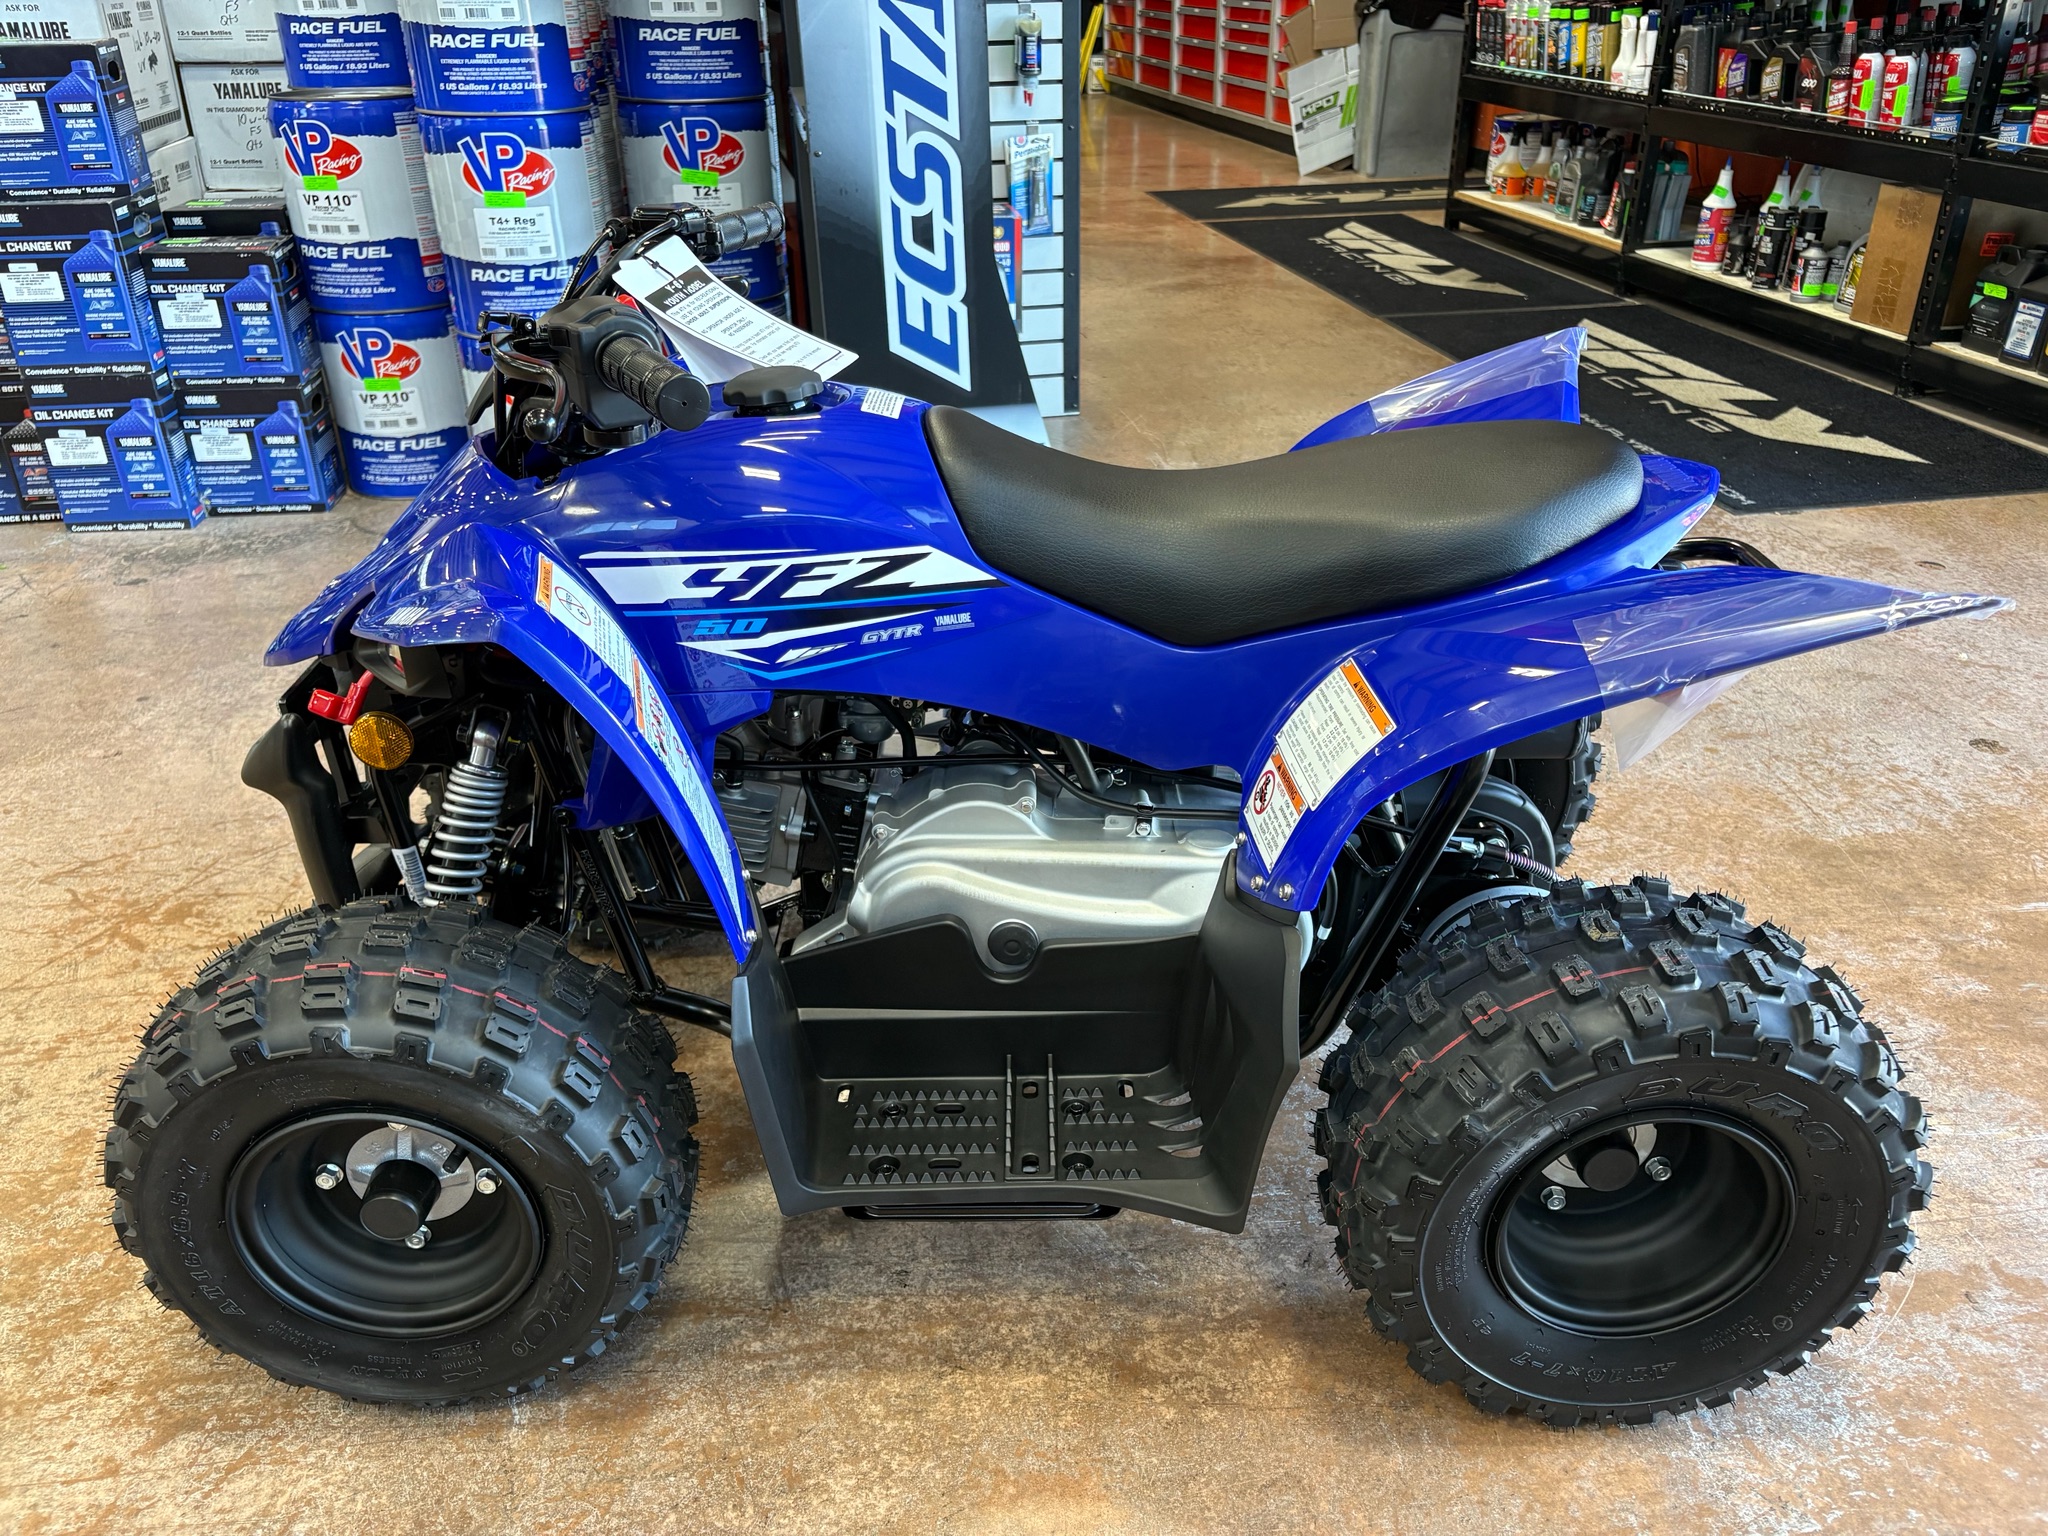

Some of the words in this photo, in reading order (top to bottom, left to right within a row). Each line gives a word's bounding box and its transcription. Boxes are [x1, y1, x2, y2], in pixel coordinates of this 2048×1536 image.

[23, 4, 40, 12] FOR
[0, 22, 71, 39] AMALUBE
[290, 22, 334, 35] RACE
[338, 21, 387, 34] FUEL
[639, 28, 691, 41] RACE
[696, 27, 741, 41] FUEL
[430, 34, 485, 48] RACE
[491, 33, 545, 48] FUEL
[230, 68, 244, 76] ASK
[245, 67, 260, 75] FOR
[314, 63, 338, 71] Gallons
[345, 62, 367, 70] 18.93
[664, 72, 692, 80] Gallons
[0, 83, 29, 93] ANGE
[29, 82, 46, 92] KIT
[458, 83, 489, 91] Gallons
[524, 82, 547, 90] Liters
[59, 103, 94, 113] YAMALUBE
[279, 120, 333, 176] VP
[317, 153, 362, 176] Racing
[660, 117, 721, 171] VP
[704, 149, 744, 171] Racing
[457, 132, 527, 192] VP
[508, 168, 555, 191] Racing
[9, 189, 48, 197] Convenience
[52, 188, 82, 196] Durability
[86, 186, 116, 194] Reliability
[693, 185, 720, 196] T2+
[303, 194, 319, 206] VP
[325, 195, 351, 206] 110
[172, 217, 204, 226] YAMALUBE
[489, 217, 510, 226] T4+
[514, 216, 536, 227] Reg
[6, 242, 53, 252] CHANGE
[54, 241, 72, 250] KIT
[301, 245, 338, 259] RACE
[342, 245, 393, 259] FUEL
[152, 258, 186, 267] YAMALUBE
[1308, 237, 1412, 286] RACING
[77, 273, 112, 282] YAMALUBE
[471, 269, 524, 283] RACE
[151, 285, 168, 294] OIL
[170, 284, 208, 293] CHANGE
[209, 284, 226, 292] KIT
[664, 291, 687, 307] YOUTH
[236, 302, 268, 312] YAMALUBE
[335, 327, 393, 379] VP
[377, 356, 421, 378] Racing
[25, 368, 69, 376] Convenience
[74, 366, 106, 374] Durability
[112, 365, 145, 373] Reliability
[2, 385, 23, 393] BOTT
[31, 384, 64, 394] YAMALUBE
[185, 395, 217, 405] YAMALUBE
[359, 393, 377, 404] VP
[385, 391, 409, 403] 110
[1579, 362, 1733, 434] ACING
[34, 411, 51, 420] OIL
[52, 409, 96, 419] CHANGE
[98, 408, 114, 418] KIT
[183, 420, 199, 429] OIL
[201, 419, 238, 429] CHANGE
[240, 418, 255, 428] KIT
[119, 437, 152, 447] YAMALUBE
[265, 436, 296, 445] YAMALUBE
[353, 438, 395, 451] RACE
[400, 436, 447, 451] FUEL
[934, 612, 972, 626] YAMALUBE
[693, 618, 768, 636] 50
[860, 623, 924, 645] GYTR
[1356, 686, 1377, 714] WARNING
[1280, 768, 1297, 800] WARNING
